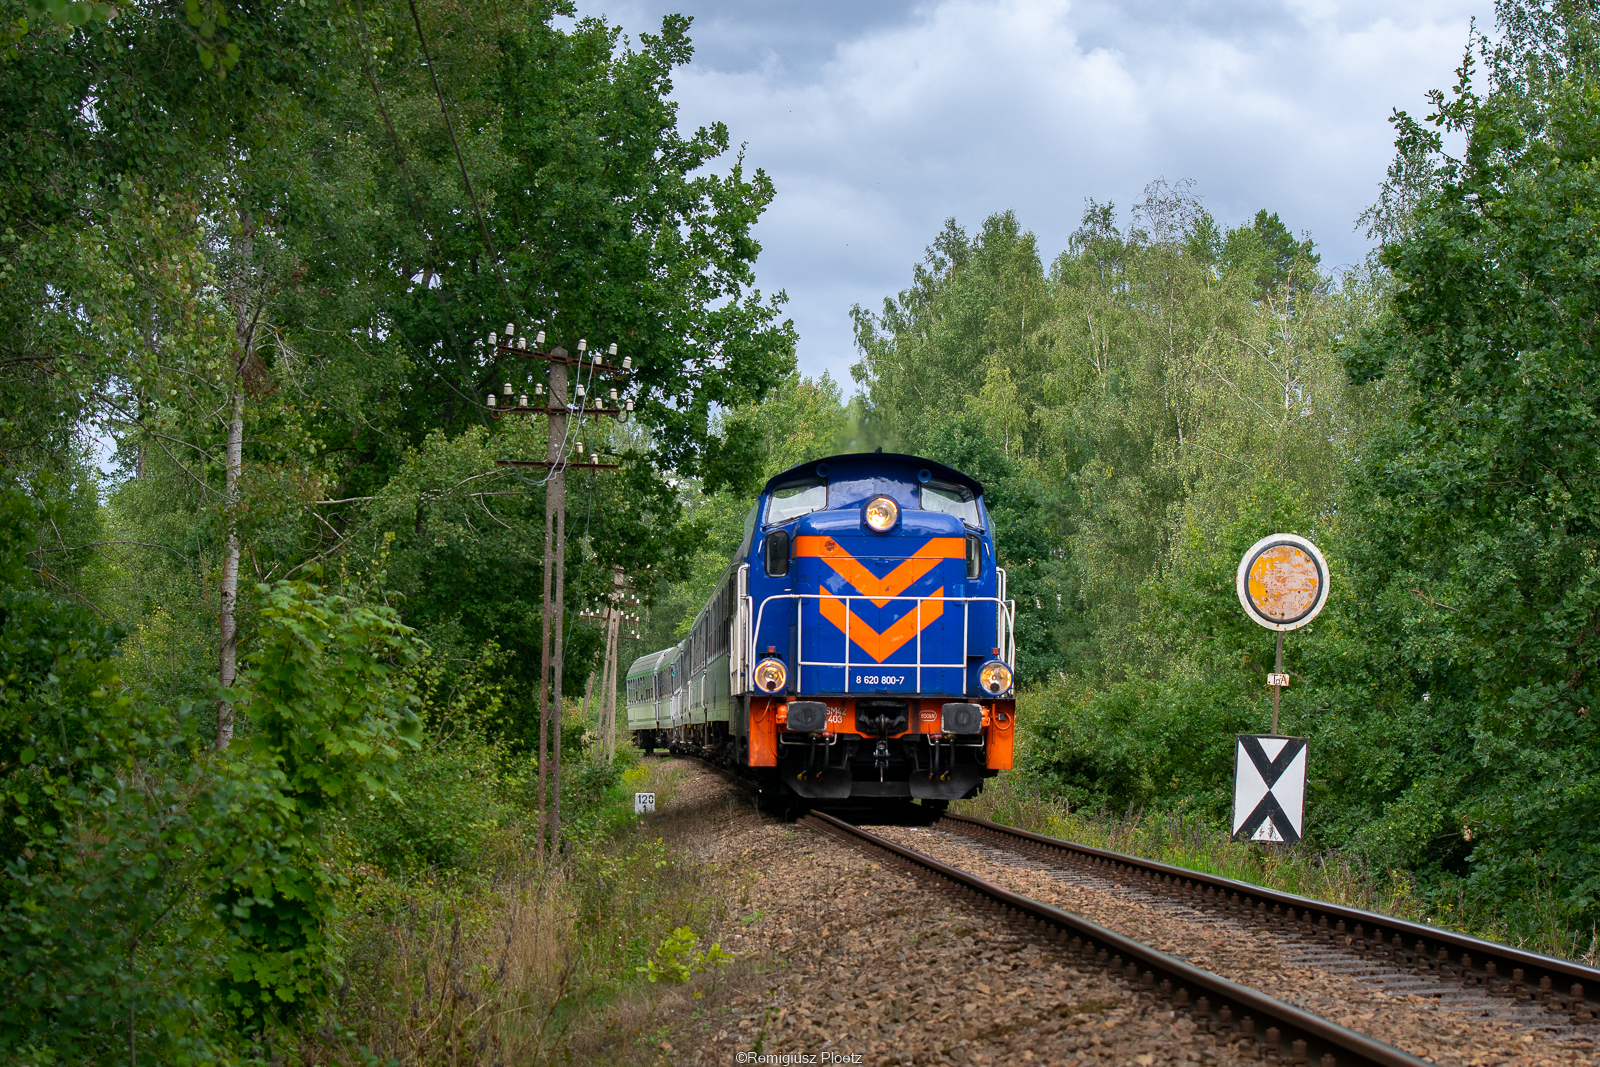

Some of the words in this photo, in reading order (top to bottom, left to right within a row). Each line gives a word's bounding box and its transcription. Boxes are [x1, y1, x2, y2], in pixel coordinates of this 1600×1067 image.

[856, 675, 862, 684] 8
[864, 675, 879, 685] 620
[881, 676, 905, 685] 800-7
[827, 706, 846, 716] SM42
[828, 715, 842, 724] 403
[638, 795, 654, 804] 120
